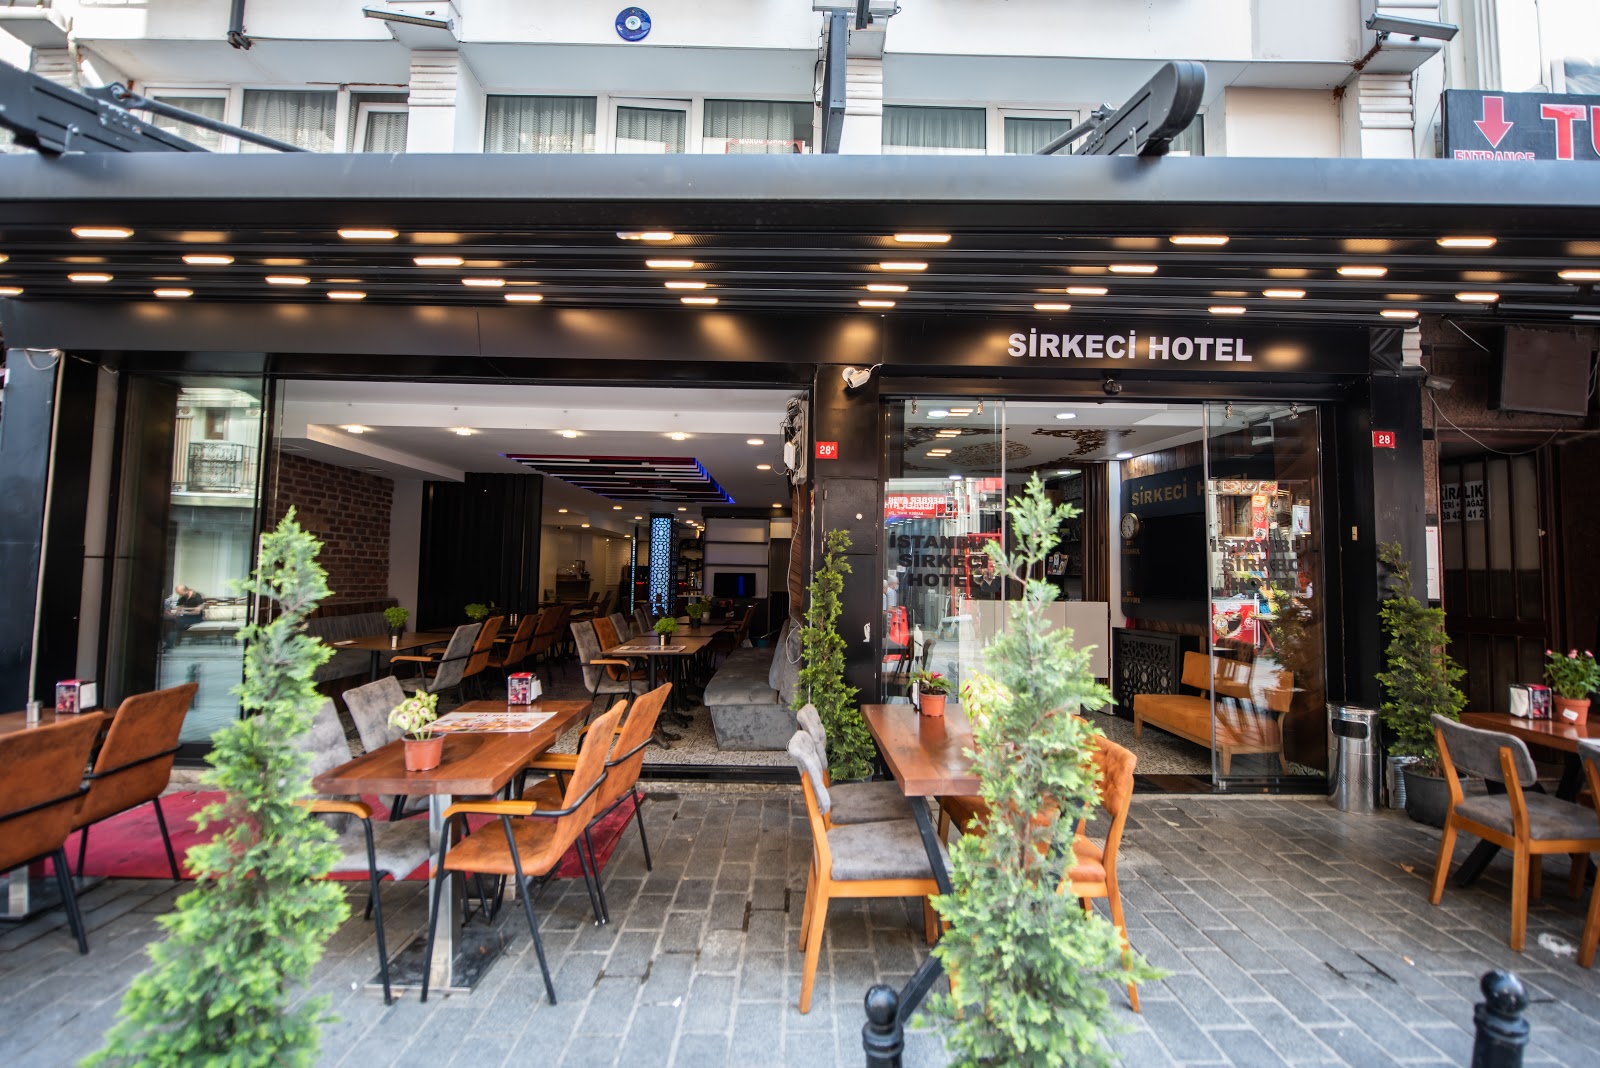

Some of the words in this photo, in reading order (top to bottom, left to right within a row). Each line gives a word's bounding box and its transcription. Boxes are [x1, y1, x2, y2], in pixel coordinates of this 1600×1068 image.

[1453, 149, 1536, 160] ENTRANCE
[1007, 328, 1136, 359] SİRKECİ
[1148, 336, 1253, 362] HOTEL
[1378, 434, 1391, 445] 28
[1131, 477, 1188, 507] SİRKECİ
[889, 531, 989, 549] İSTANBU
[908, 573, 981, 587] HOTEL
